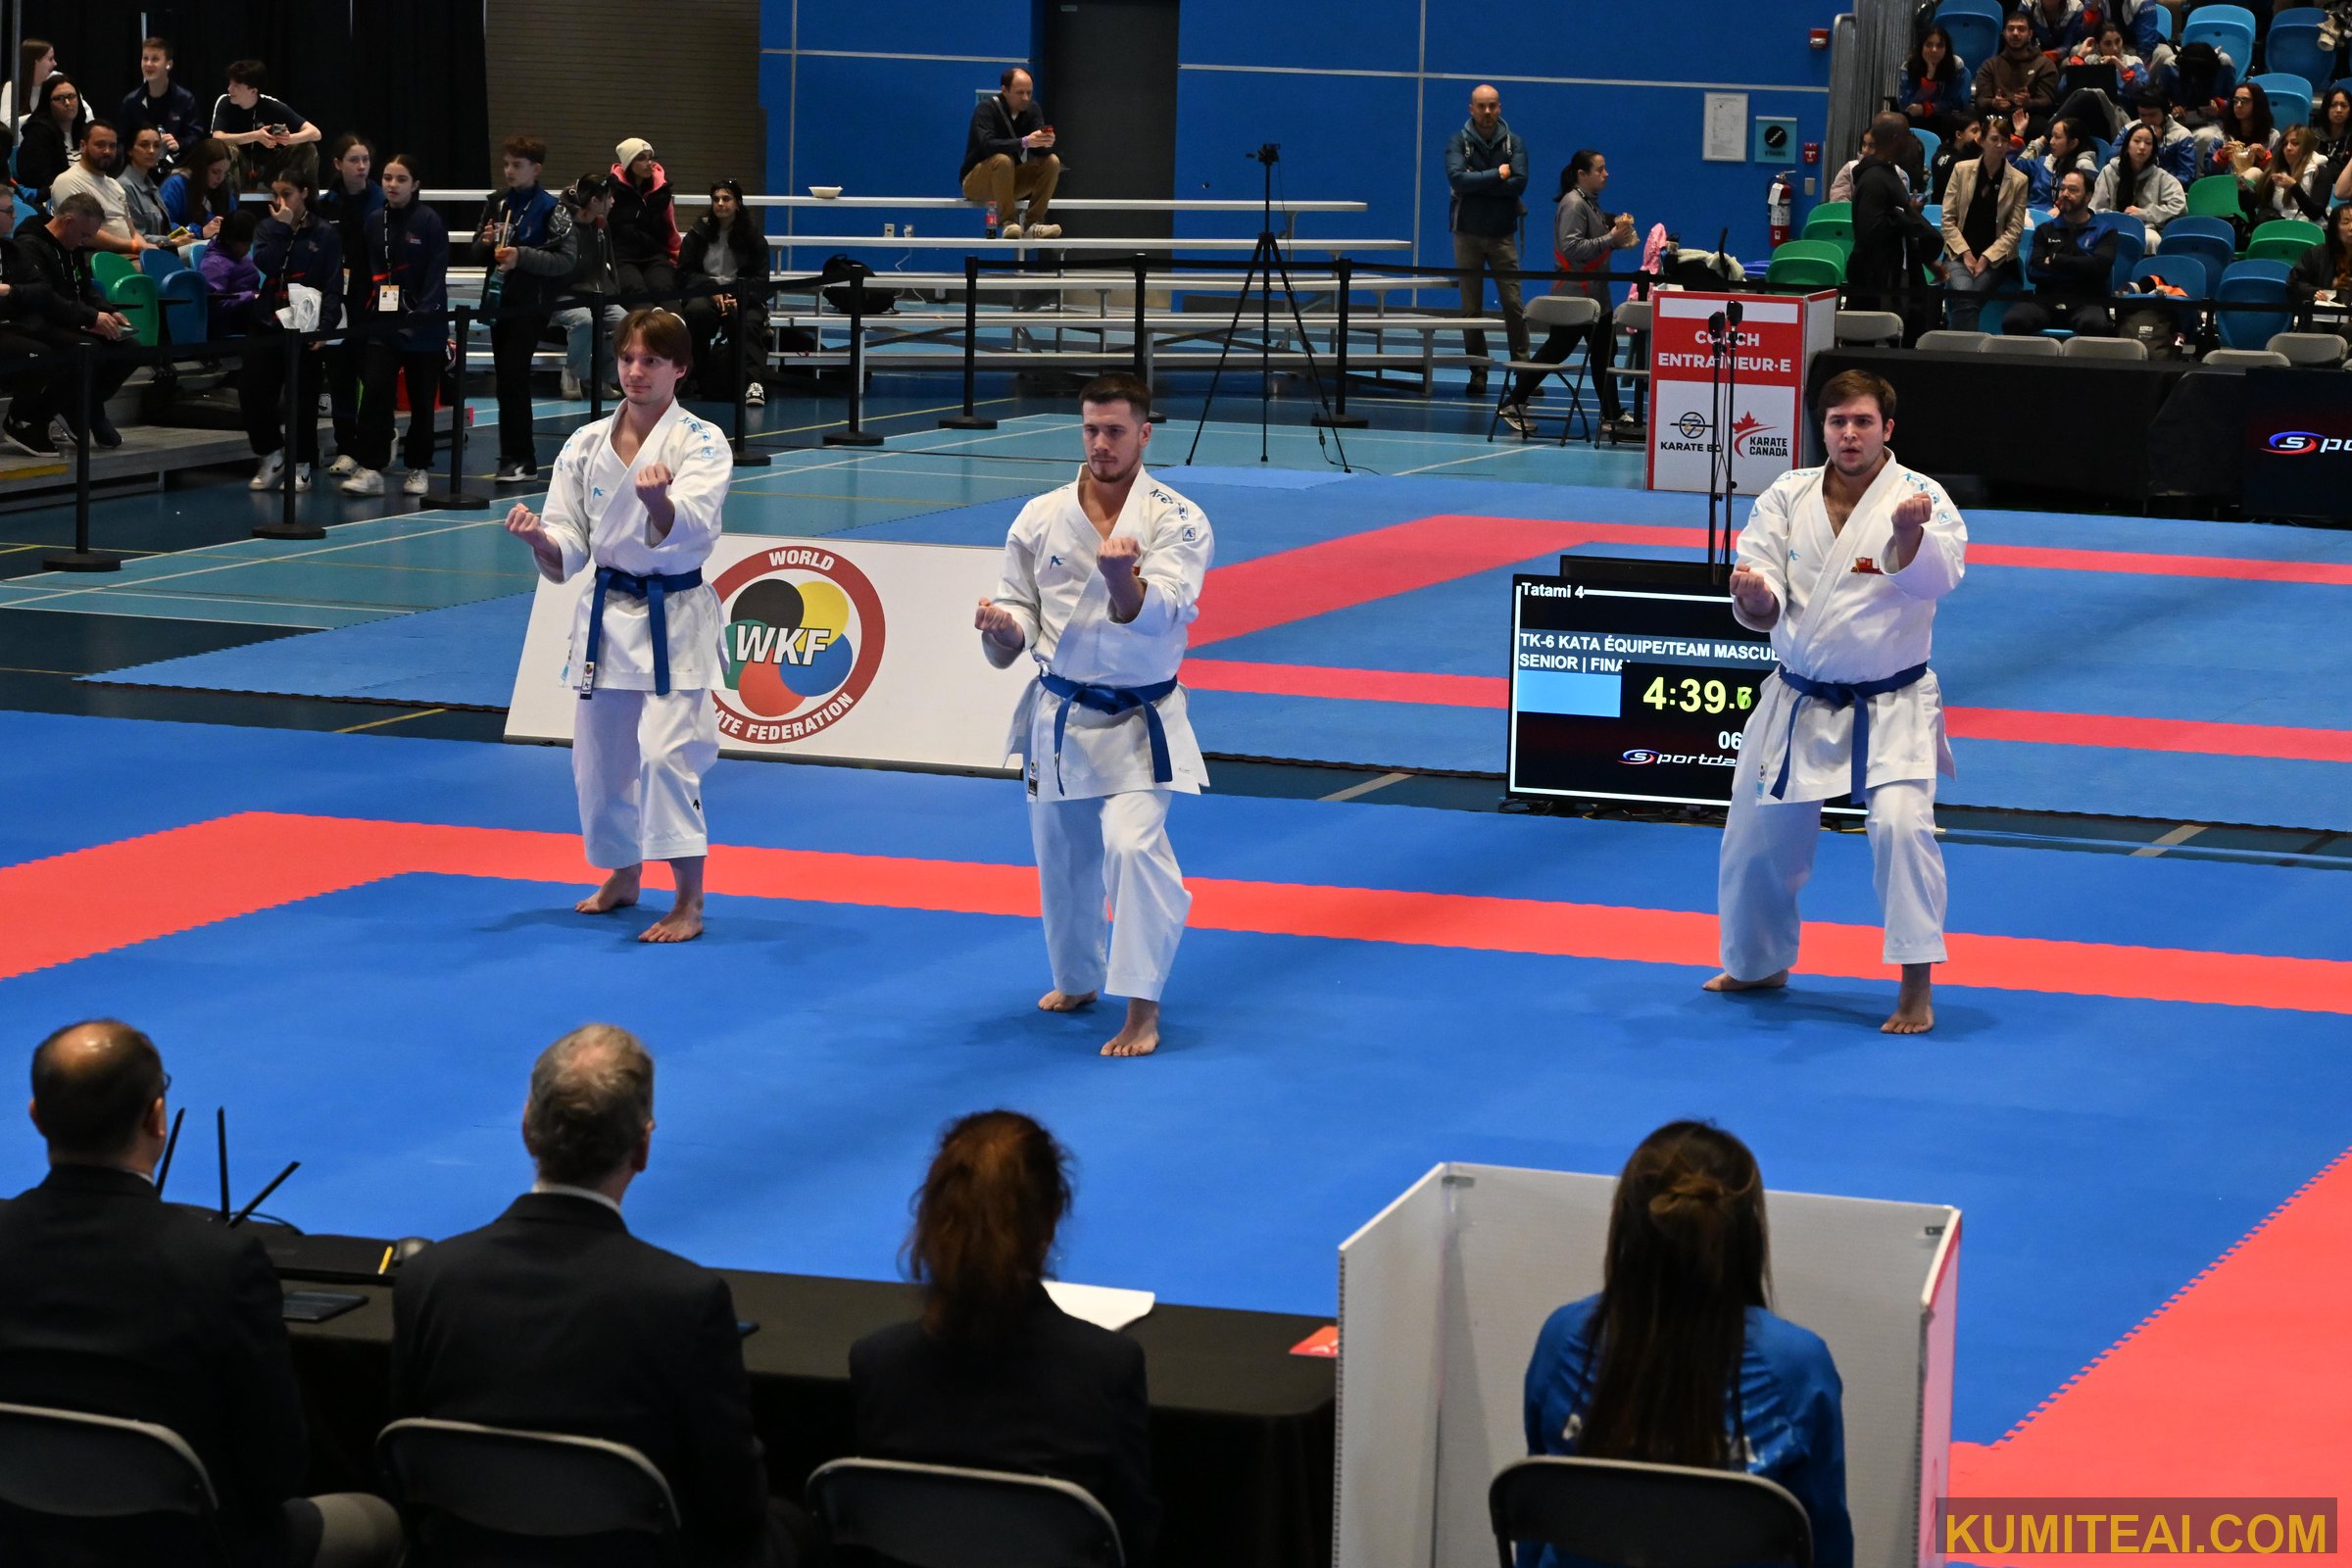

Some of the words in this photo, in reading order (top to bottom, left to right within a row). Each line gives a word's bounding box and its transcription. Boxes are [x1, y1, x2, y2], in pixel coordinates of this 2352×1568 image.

[1660, 442, 1704, 452] KARATE
[1749, 436, 1788, 447] KARATE
[1749, 447, 1788, 458] CANADA
[768, 550, 835, 571] WORLD
[1521, 582, 1572, 599] Tatami
[1574, 585, 1585, 600] 4
[736, 624, 831, 666] WKF
[1520, 632, 1555, 649] TK-6
[1558, 635, 1601, 651] KATA
[1604, 635, 1711, 658] ÉQUIPE/TEAM
[1519, 654, 1578, 669] SENIOR
[1591, 658, 1631, 672] FINA
[746, 692, 855, 741] FEDERATION
